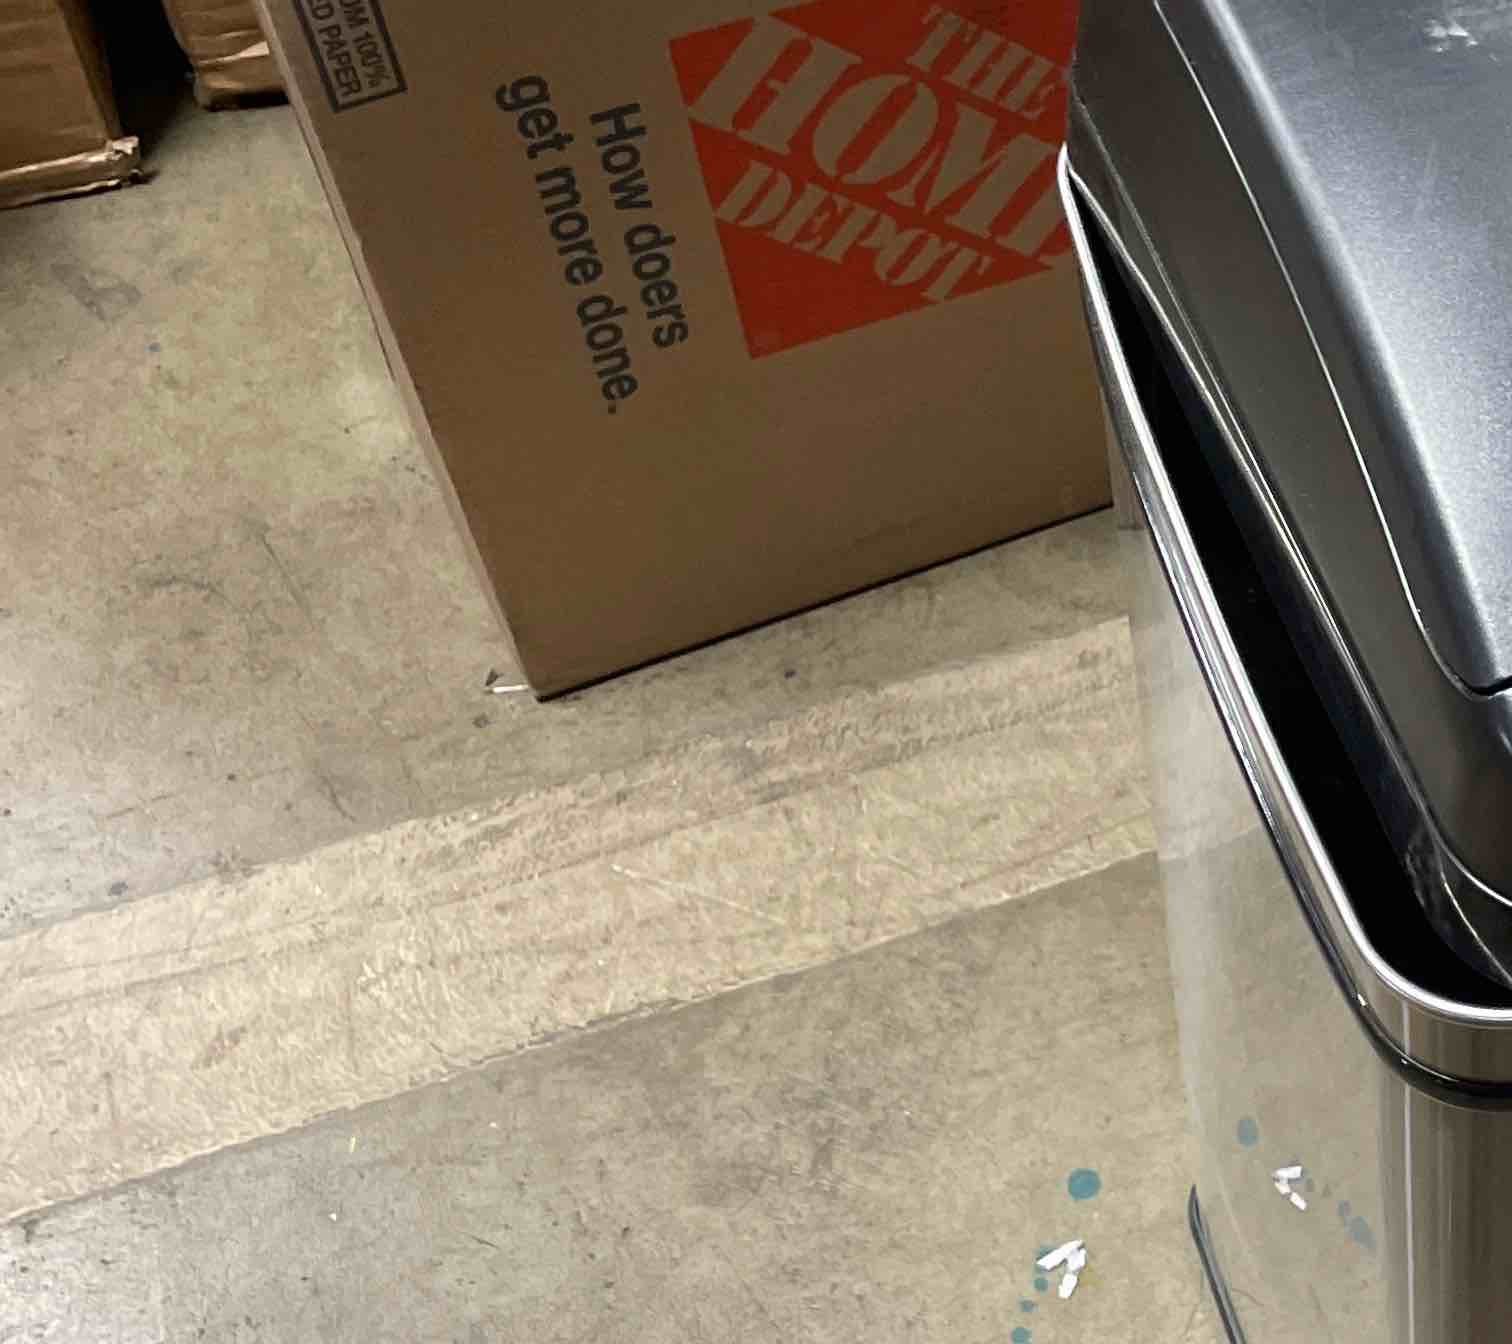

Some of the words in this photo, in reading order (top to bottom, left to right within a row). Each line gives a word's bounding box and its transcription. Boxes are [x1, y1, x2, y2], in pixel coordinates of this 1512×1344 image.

[318, 24, 362, 97] PAPER
[352, 29, 391, 89] 100%
[905, 2, 1063, 120] THE
[496, 74, 575, 160] get
[536, 166, 604, 286] more
[576, 293, 640, 415] done.
[589, 104, 653, 214] How
[625, 222, 689, 349] doers
[714, 161, 996, 303] DEPOT
